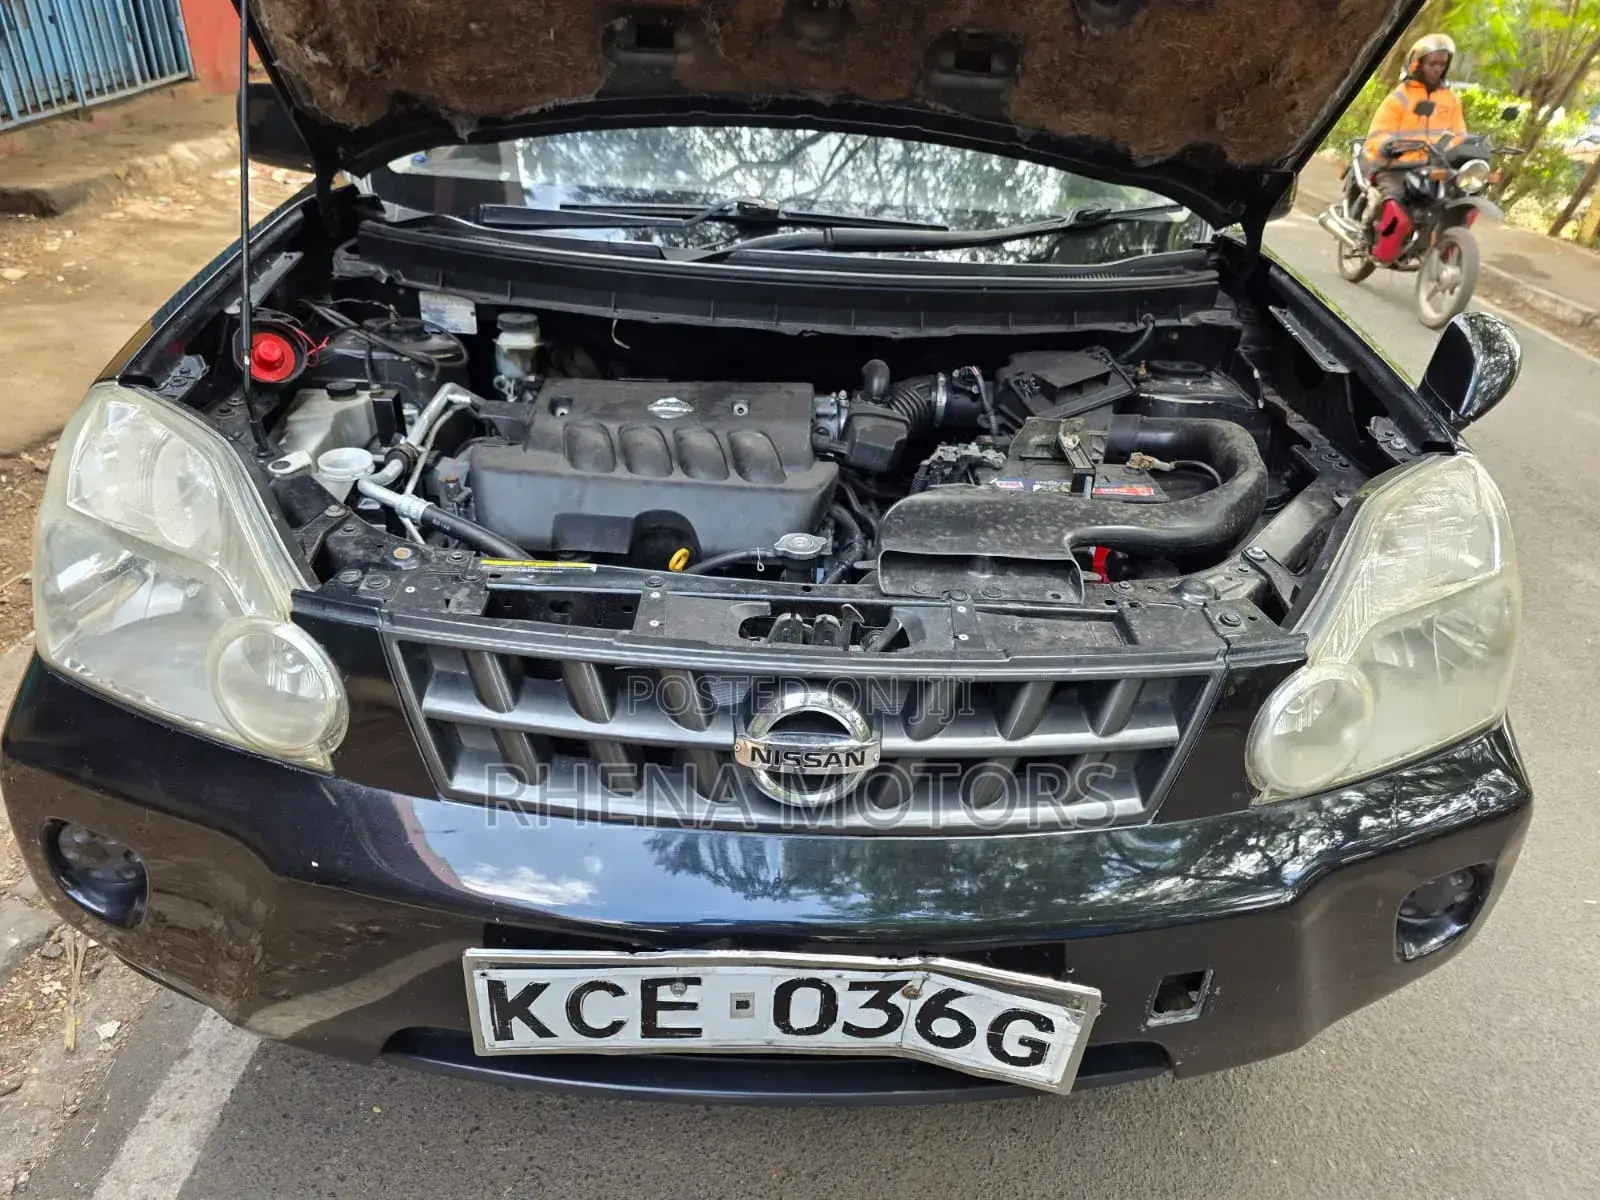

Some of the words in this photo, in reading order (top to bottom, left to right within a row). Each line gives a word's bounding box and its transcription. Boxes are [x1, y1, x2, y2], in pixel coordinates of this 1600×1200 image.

[750, 746, 866, 768] NISSAN
[488, 977, 703, 1041] KCE
[772, 977, 1057, 1067] 036G
